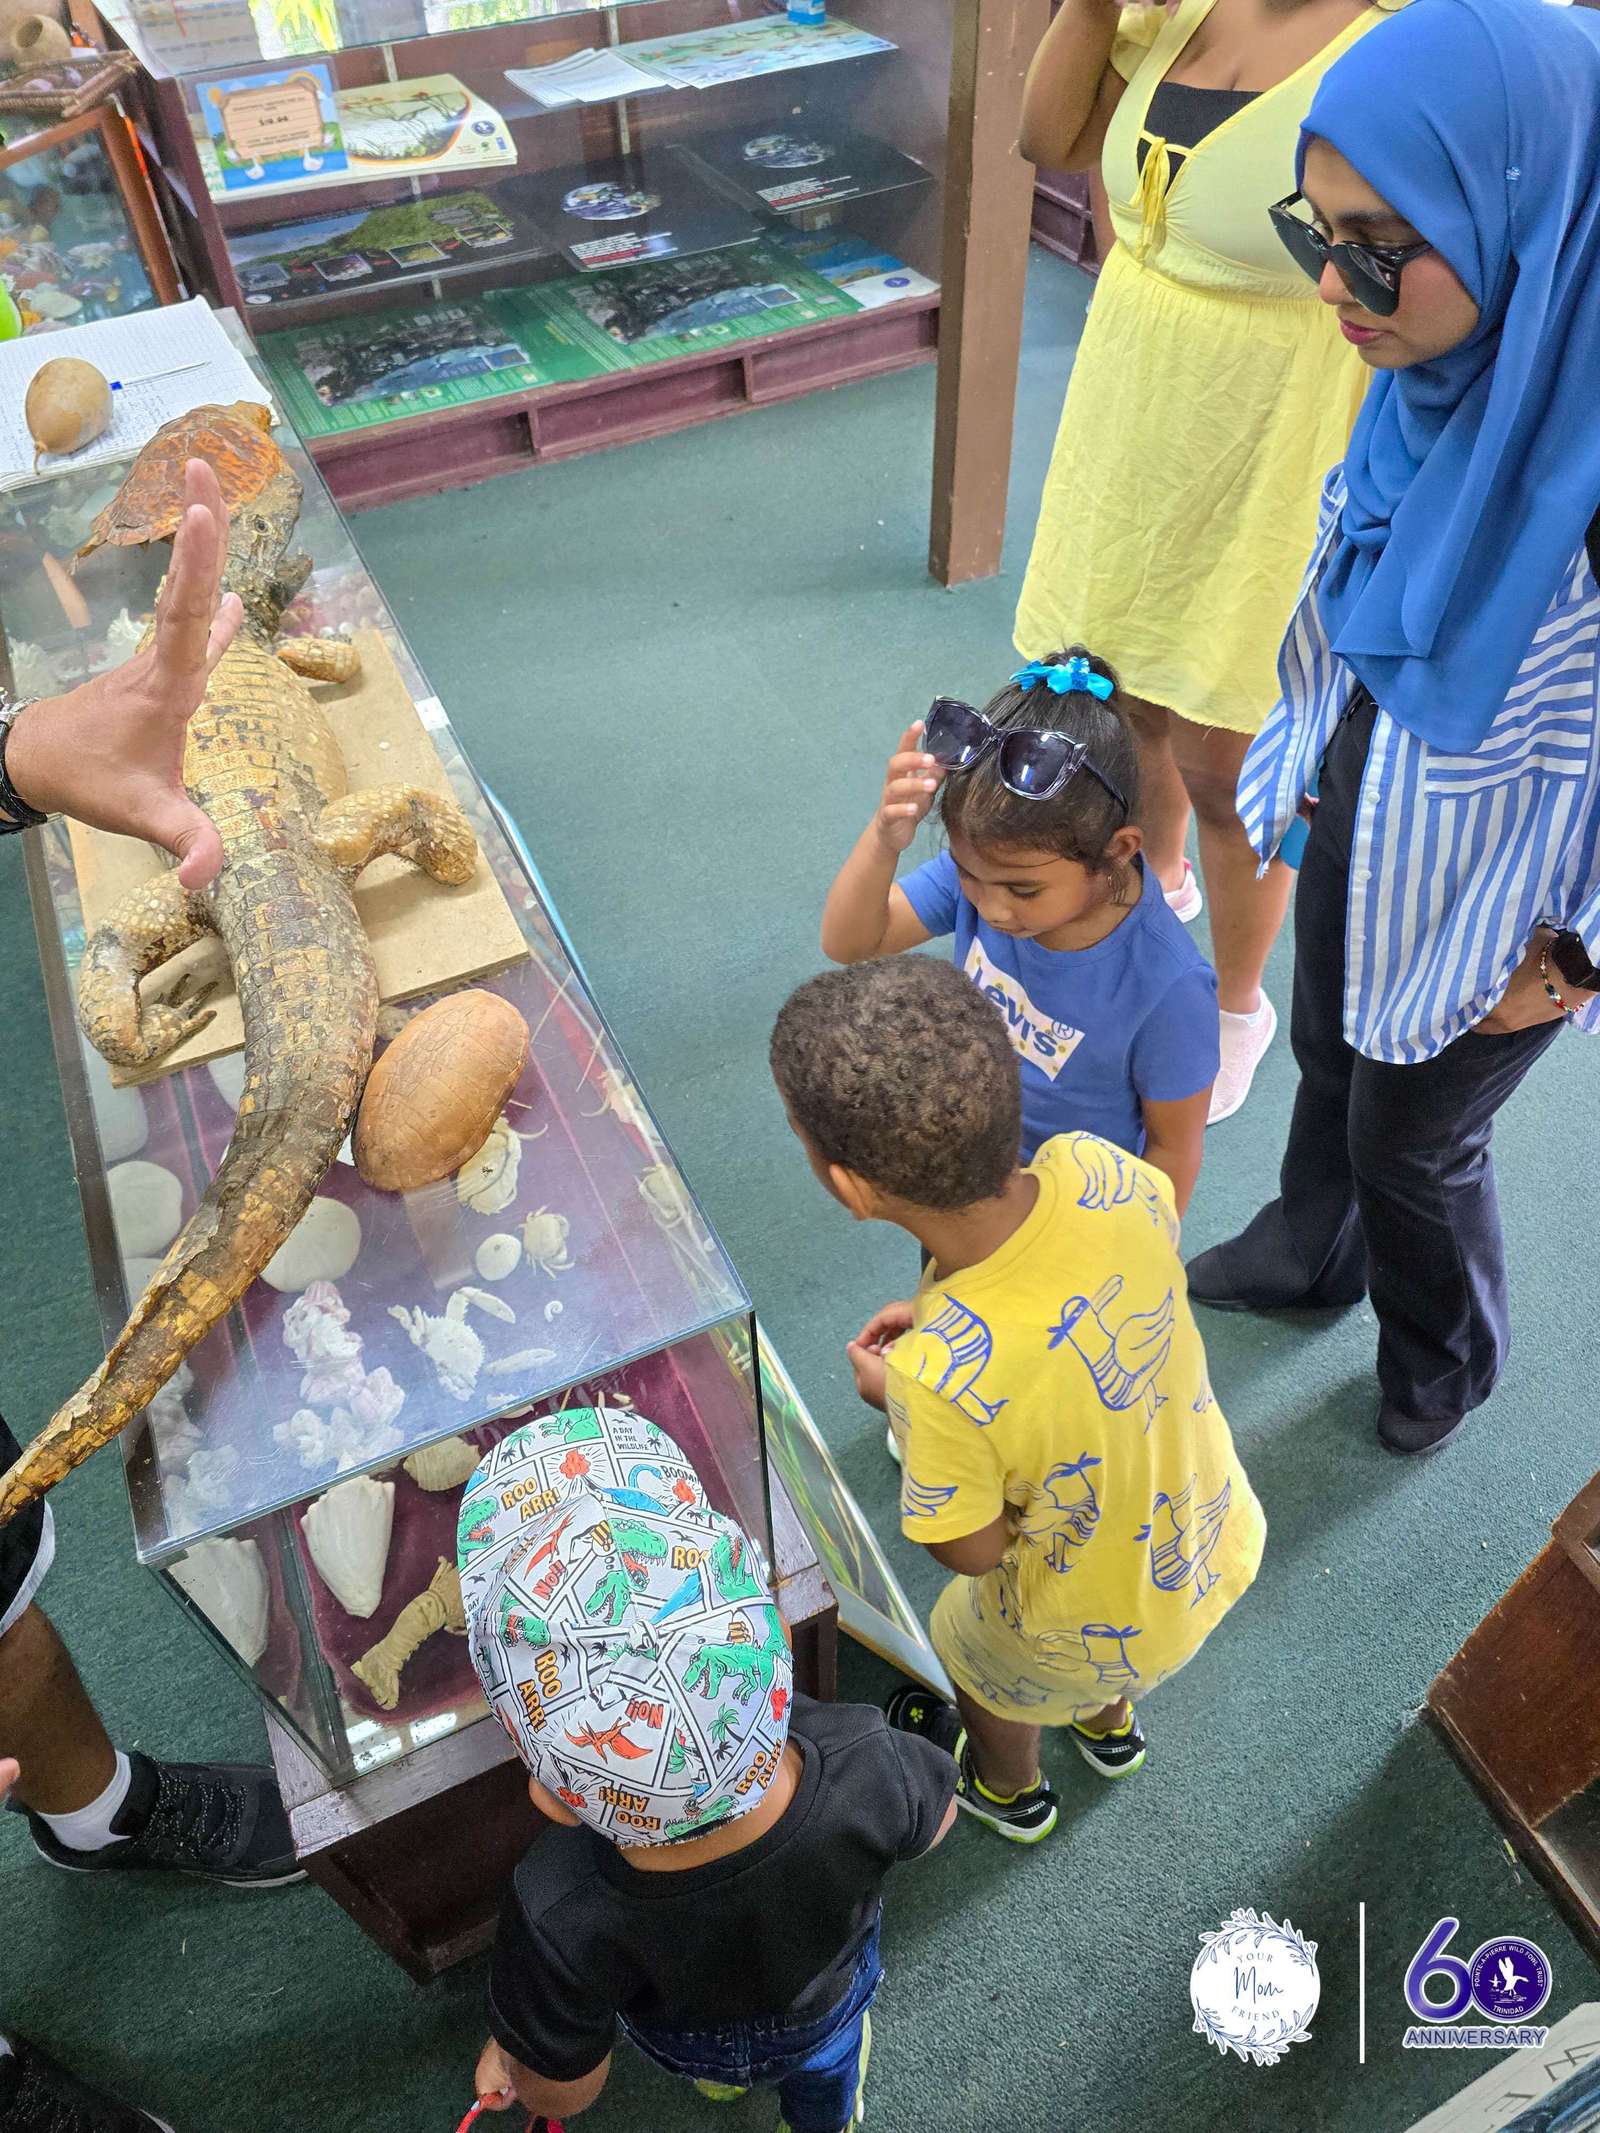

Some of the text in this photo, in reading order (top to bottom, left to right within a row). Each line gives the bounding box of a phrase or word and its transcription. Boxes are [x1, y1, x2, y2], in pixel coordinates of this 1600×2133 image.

[619, 1426, 633, 1435] DAY
[624, 1434, 637, 1442] THE
[616, 1442, 649, 1451] WILDLIFE
[501, 1476, 538, 1512] ROO
[519, 1487, 562, 1524] ARR!
[671, 1546, 709, 1570] RO
[534, 1650, 562, 1699] ROO
[517, 1679, 547, 1734] ARR!
[735, 1751, 767, 1796] ROO
[598, 1785, 650, 1813] ARR!
[615, 1810, 662, 1831] ROO
